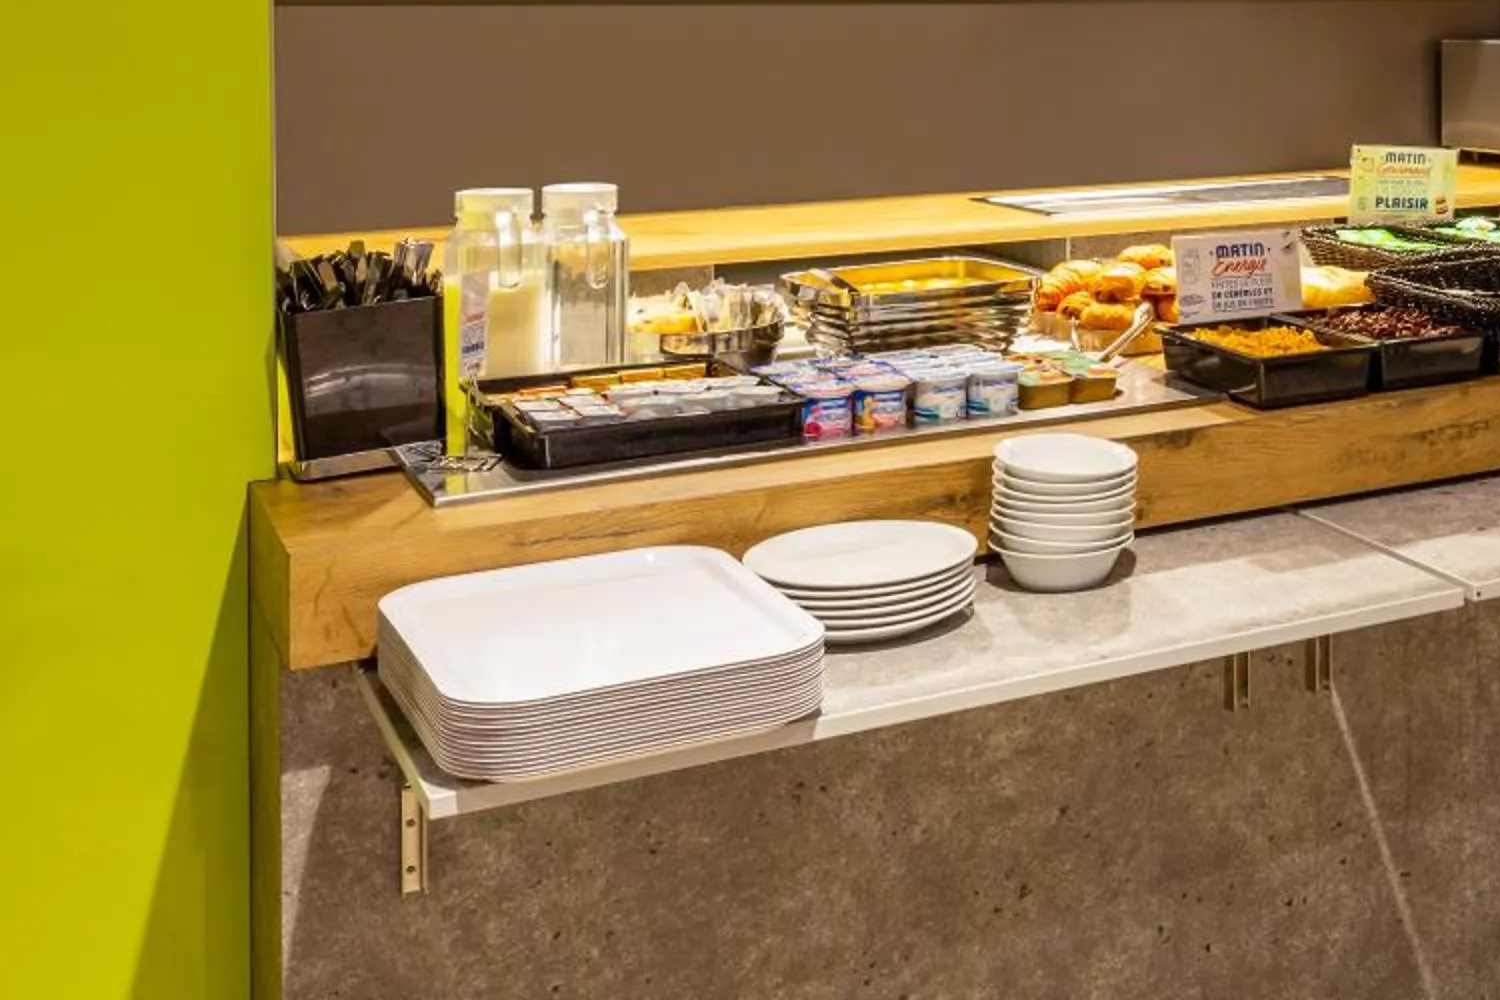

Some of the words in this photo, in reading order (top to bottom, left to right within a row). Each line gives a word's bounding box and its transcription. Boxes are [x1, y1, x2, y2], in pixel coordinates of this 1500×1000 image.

[1384, 150, 1427, 165] MATIN
[1374, 196, 1429, 210] PLAISIR
[1215, 242, 1265, 258] MATIN
